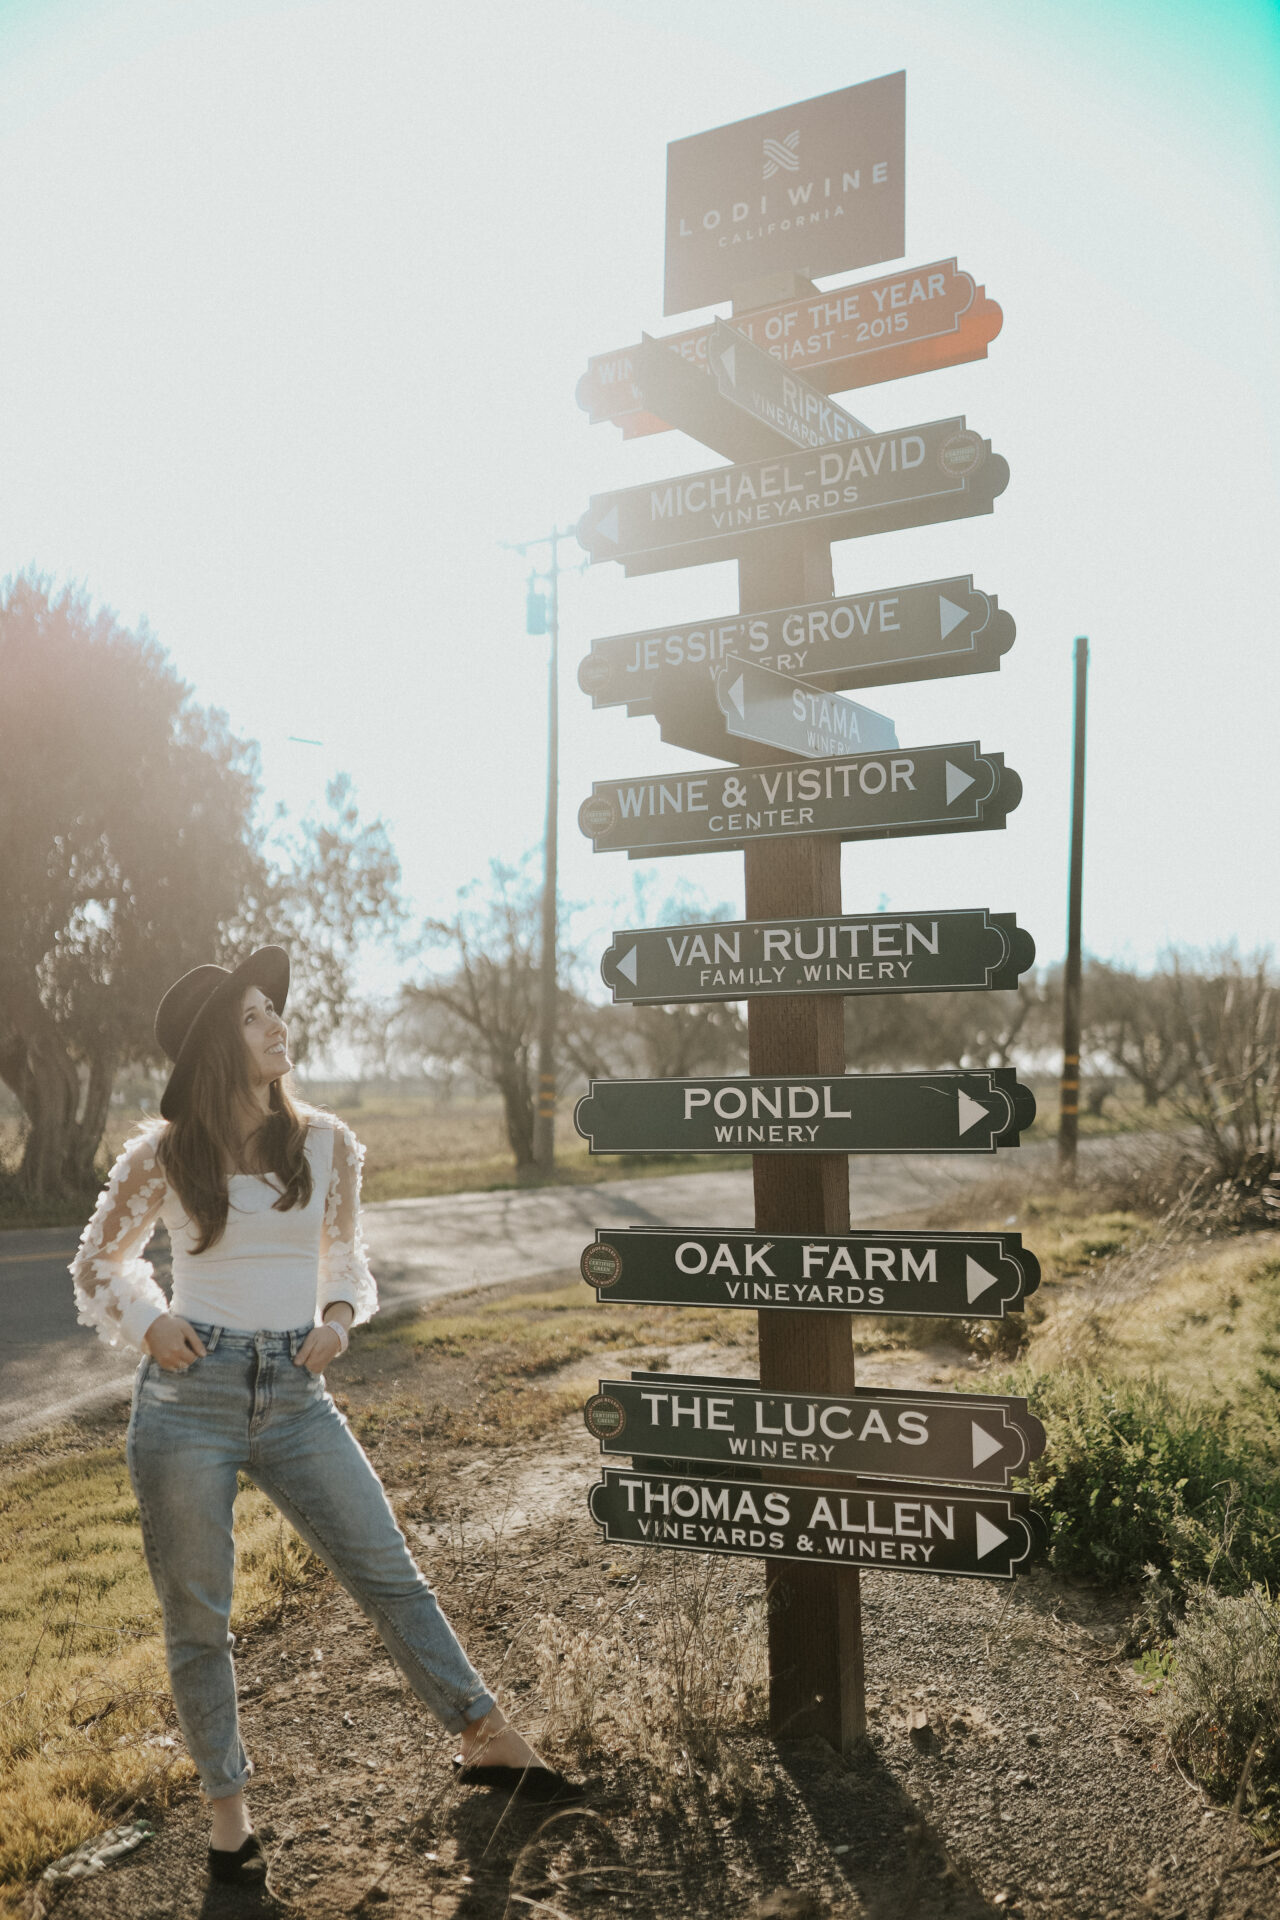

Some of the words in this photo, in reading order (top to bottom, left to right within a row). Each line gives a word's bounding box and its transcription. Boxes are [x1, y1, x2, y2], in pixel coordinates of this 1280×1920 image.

[679, 195, 767, 236] LODI
[787, 162, 888, 206] WINE
[718, 205, 844, 247] CALIFORNIA
[765, 310, 797, 341] OF
[808, 296, 860, 330] THE
[871, 273, 946, 312] YEAR
[856, 312, 909, 342] 2015
[651, 435, 925, 520] MICHAEL-DAVID
[712, 487, 858, 528] VINEYARDS
[626, 620, 768, 672] JESSIE'S
[782, 598, 900, 648] GROVE
[792, 688, 860, 743] STAMA
[617, 779, 708, 818] WINE
[721, 776, 747, 808] &
[759, 759, 917, 805] VISITOR
[709, 807, 814, 832] CENTER
[666, 932, 741, 966] VAN
[764, 921, 940, 961] RUITEN
[700, 966, 786, 986] FAMILY
[803, 961, 913, 981] WINERY
[683, 1085, 852, 1120] PONDL
[714, 1125, 820, 1142] WINERY
[674, 1242, 776, 1277] OAK
[802, 1245, 938, 1283] FARM
[725, 1281, 885, 1305] VINEYARDS
[640, 1393, 735, 1432] THE
[755, 1400, 930, 1446] LUCAS
[728, 1438, 836, 1462] WINERY
[618, 1479, 791, 1527] THOMAS
[808, 1497, 956, 1540] ALLEN
[637, 1518, 785, 1550] VINEYARDS
[796, 1535, 814, 1553] &
[825, 1537, 935, 1564] WINERY
